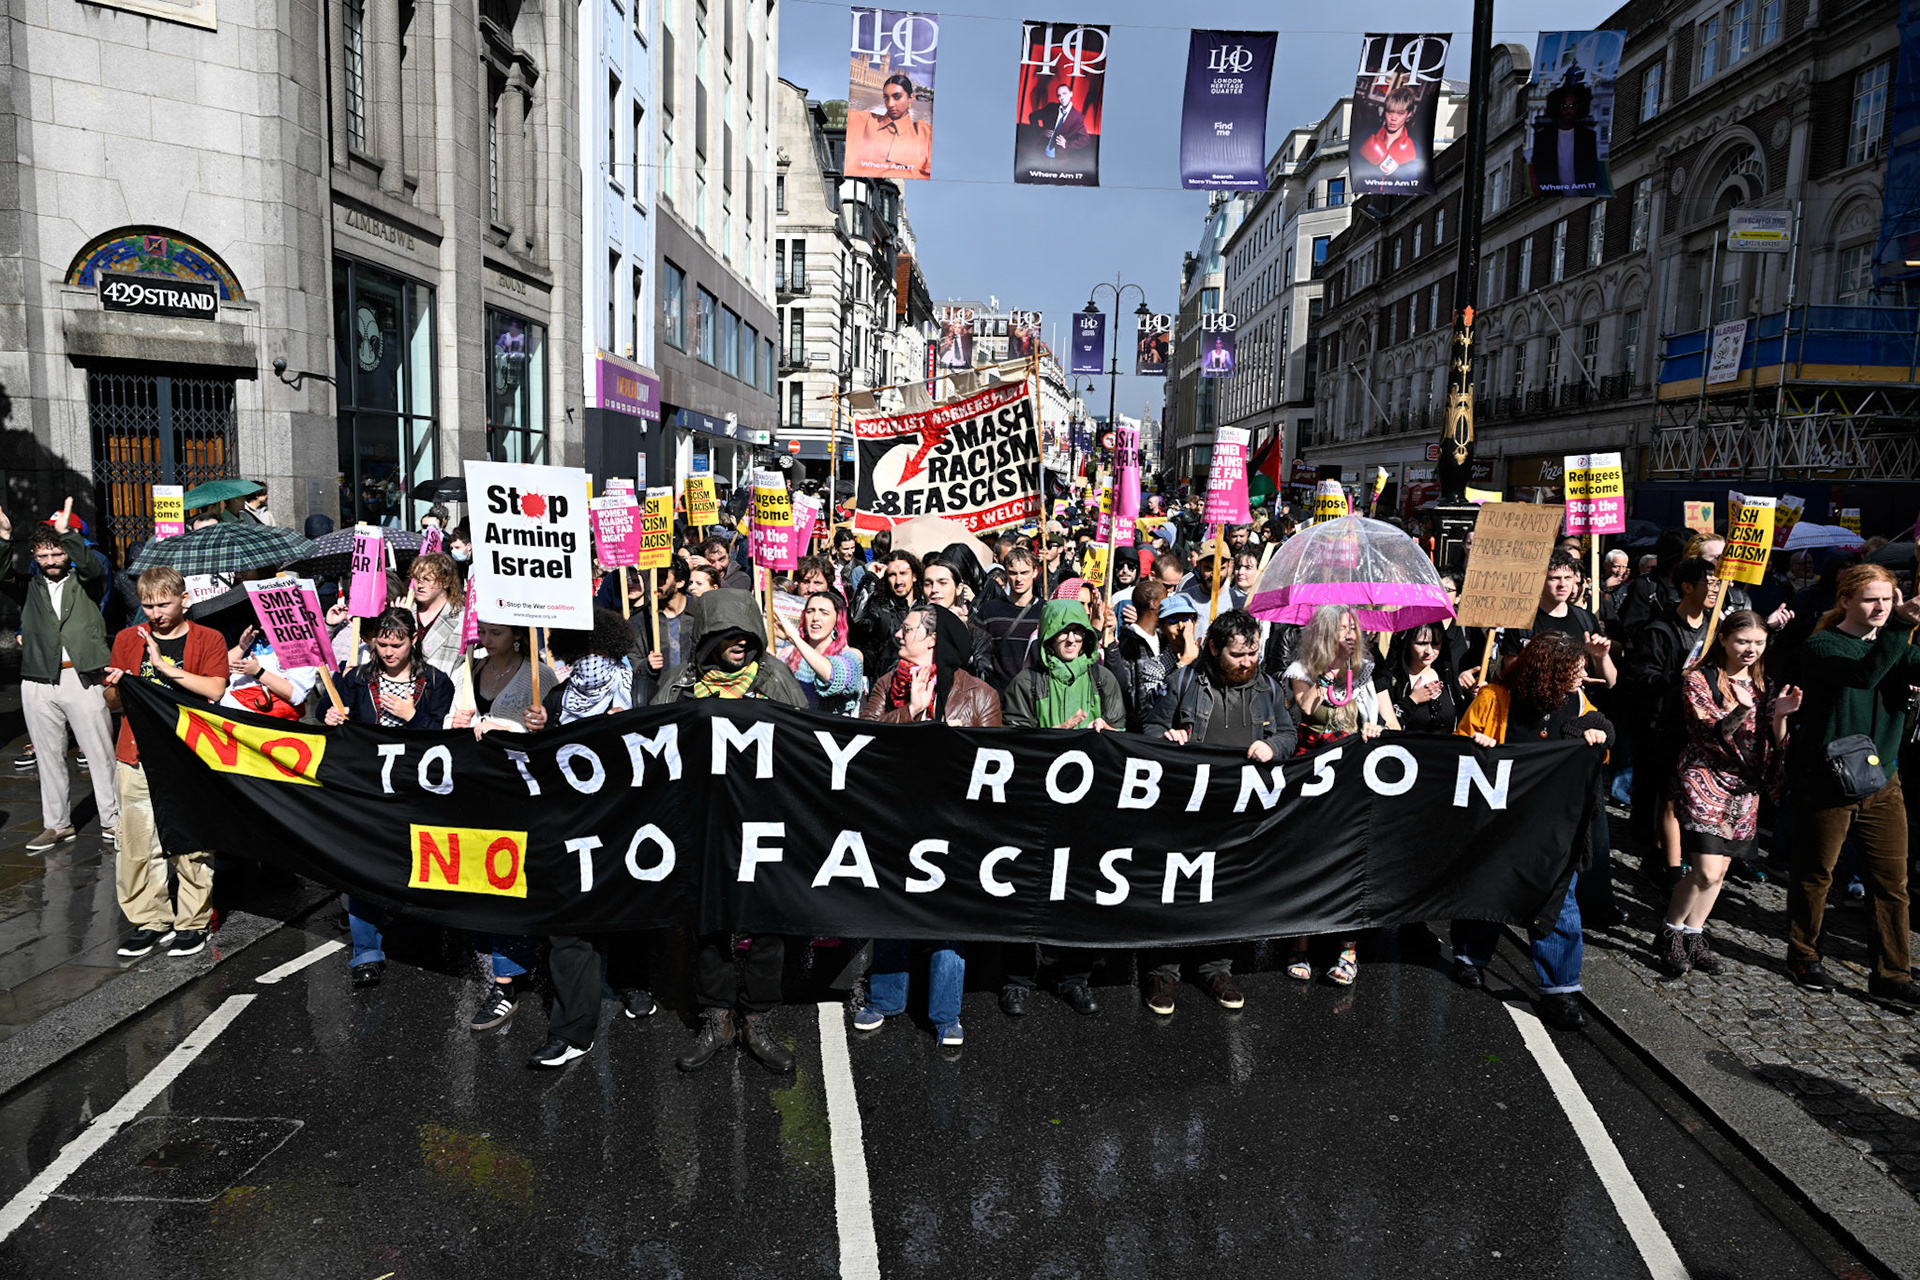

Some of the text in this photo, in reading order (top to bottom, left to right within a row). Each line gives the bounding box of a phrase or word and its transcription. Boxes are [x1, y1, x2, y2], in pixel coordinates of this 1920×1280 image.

[851, 10, 939, 67] LHQ
[1020, 23, 1109, 77] LHQ
[1207, 45, 1253, 74] LHQ
[1357, 33, 1449, 86] LHQ
[1214, 122, 1233, 130] Find
[860, 161, 889, 170] Where
[890, 162, 906, 170] Am
[1029, 170, 1058, 179] Where
[1059, 172, 1074, 180] Am
[345, 208, 415, 251] ZIMBABWE
[498, 273, 527, 295] HOUSE
[1715, 323, 1746, 336] ALARMED
[933, 399, 1034, 456] SMASH
[1115, 430, 1134, 450] SH
[928, 429, 1039, 484] RACISM
[1117, 450, 1138, 468] FAR
[1224, 468, 1242, 480] FAR
[1470, 464, 1490, 472] Pizza
[1538, 460, 1564, 482] Pizza
[1113, 468, 1125, 486] HT
[1208, 478, 1234, 490] IGHT
[1568, 471, 1620, 484] Refugees
[1569, 484, 1618, 495] welcome
[487, 484, 568, 524] Stp
[645, 500, 660, 514] SH
[757, 494, 790, 507] ugees
[1315, 499, 1346, 512] ppose
[1569, 500, 1618, 514] Stop the
[596, 508, 628, 518] WOMEN
[755, 504, 790, 521] lcome
[982, 499, 1040, 525] WELCOM
[1569, 512, 1618, 528] far right
[160, 524, 179, 534] the
[598, 516, 634, 528] AGAINST
[600, 524, 632, 535] THE FAR
[643, 516, 668, 532] CISM
[1119, 516, 1134, 529] the
[1482, 510, 1562, 534] TRUMP RAPIST
[354, 529, 371, 537] orker
[484, 522, 577, 554] Arming
[600, 534, 625, 543] RIGHT
[755, 529, 788, 544] op the
[1114, 528, 1132, 541] ight
[1731, 526, 1764, 544] CISM
[760, 544, 788, 560] right
[1472, 537, 1548, 560] FARAGE RACIST
[1726, 544, 1767, 562] ACISM
[352, 556, 371, 573] AR
[492, 550, 572, 578] Israel
[256, 580, 286, 590] Socialist
[1468, 570, 1538, 595] TOMMY NAZI
[258, 588, 304, 610] SMAS
[506, 600, 521, 610] Stop
[533, 602, 546, 610] War
[1464, 595, 1534, 612] STARMER SUPPORTS
[265, 605, 319, 628] THE FR
[1465, 608, 1524, 625] GENOCIDE
[272, 622, 314, 644] RIGH
[184, 710, 1514, 812] NO TO TOMMY ROBINSON
[418, 820, 1217, 906] NO TO FASCISM
